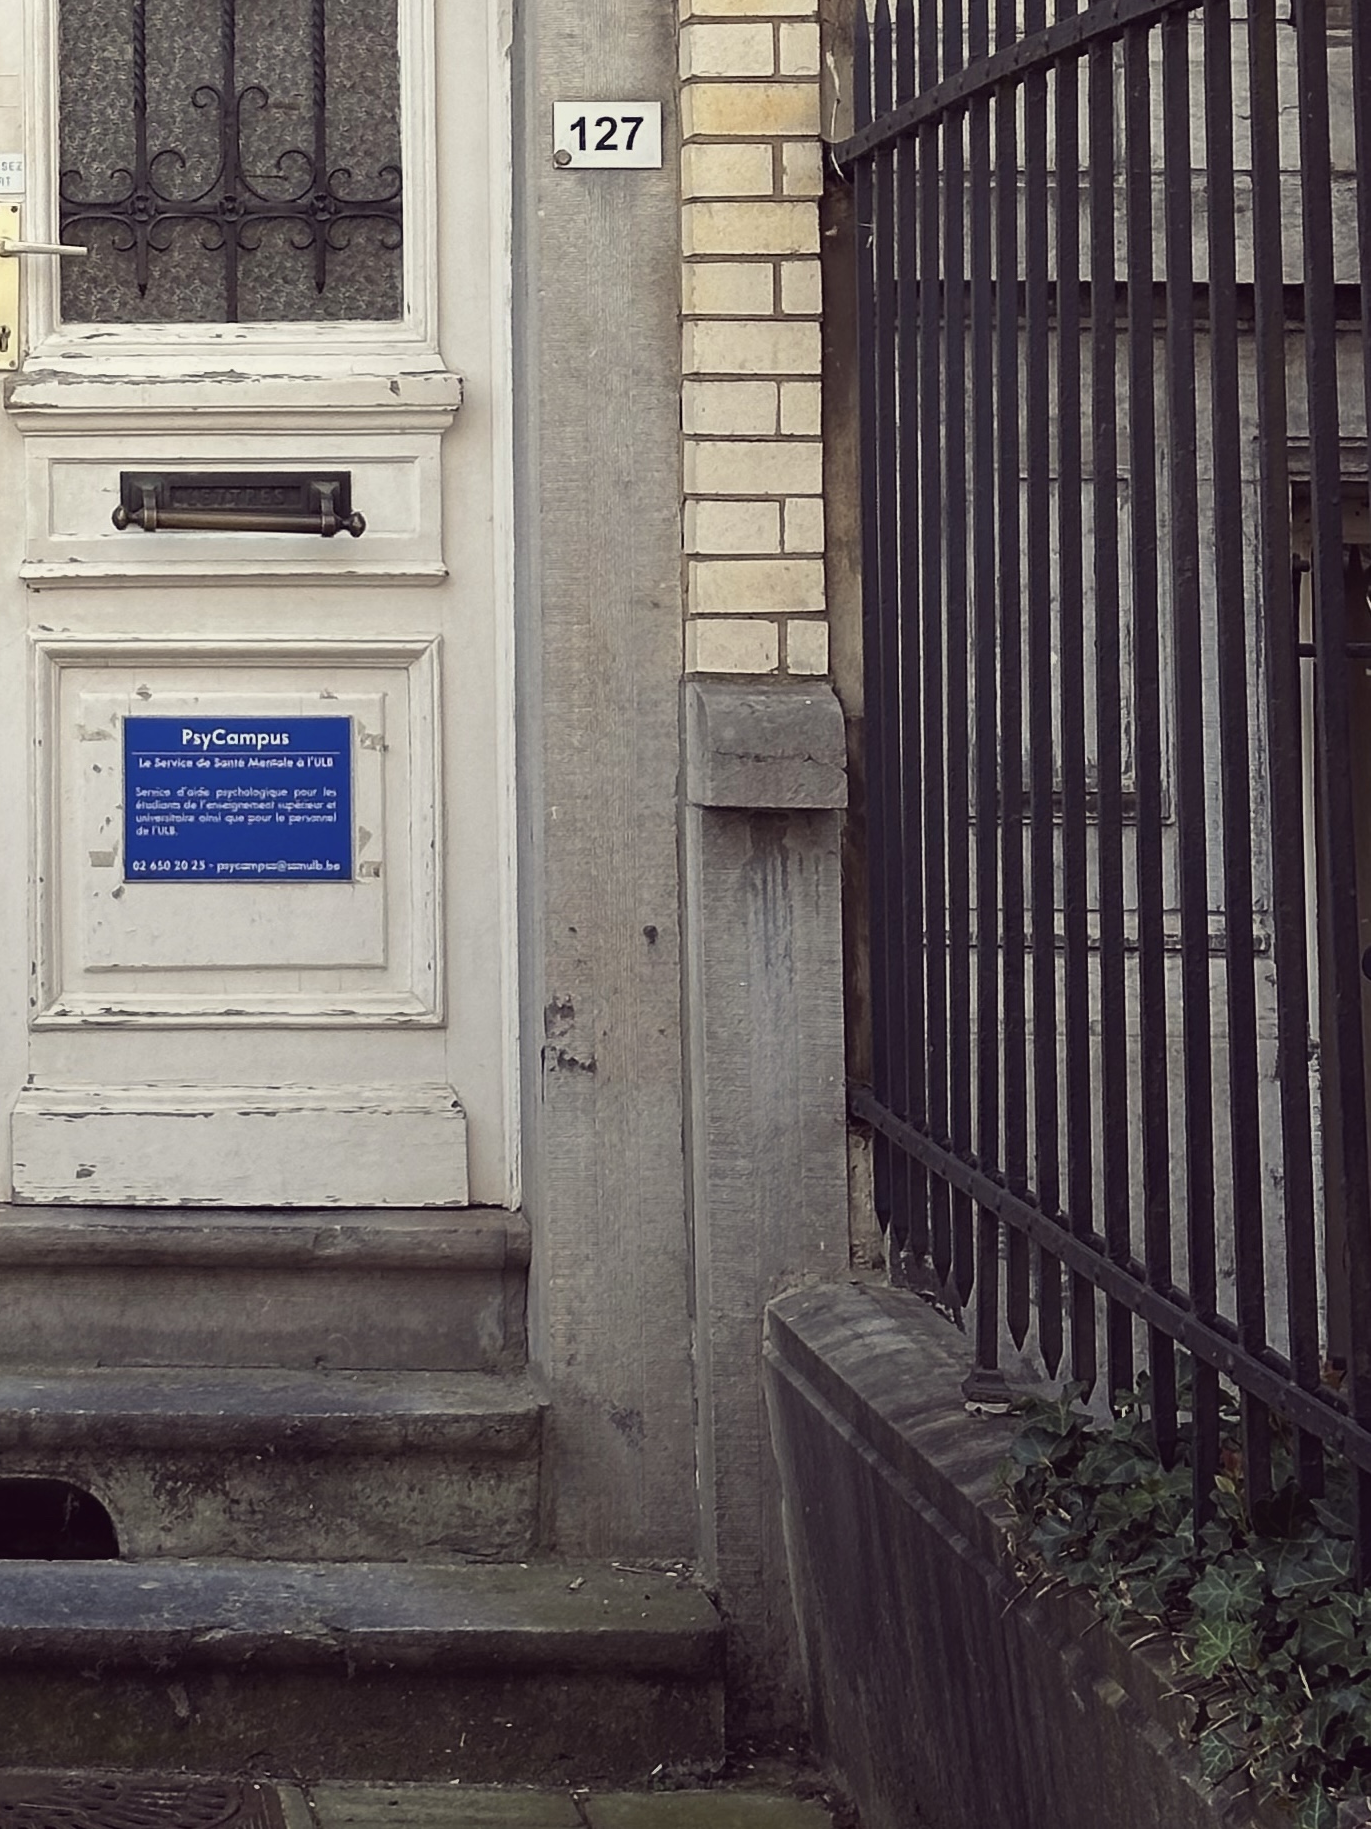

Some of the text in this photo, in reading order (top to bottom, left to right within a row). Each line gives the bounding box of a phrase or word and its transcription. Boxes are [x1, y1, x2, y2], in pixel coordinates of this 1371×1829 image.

[570, 116, 644, 151] 127
[187, 488, 285, 506] LETTRES
[182, 728, 290, 750] PsyCampus
[139, 756, 333, 768] Le Service de Santé Mentale à l'ULB
[135, 786, 337, 800] Service d'aide psychologique pour les
[183, 800, 197, 810] de
[326, 801, 337, 809] et
[135, 812, 337, 826] universitaire ainsi que pour le personnel
[136, 825, 150, 835] de
[133, 860, 146, 871] 02
[150, 860, 171, 871] 650
[174, 860, 188, 871] 20
[191, 860, 206, 871] 25
